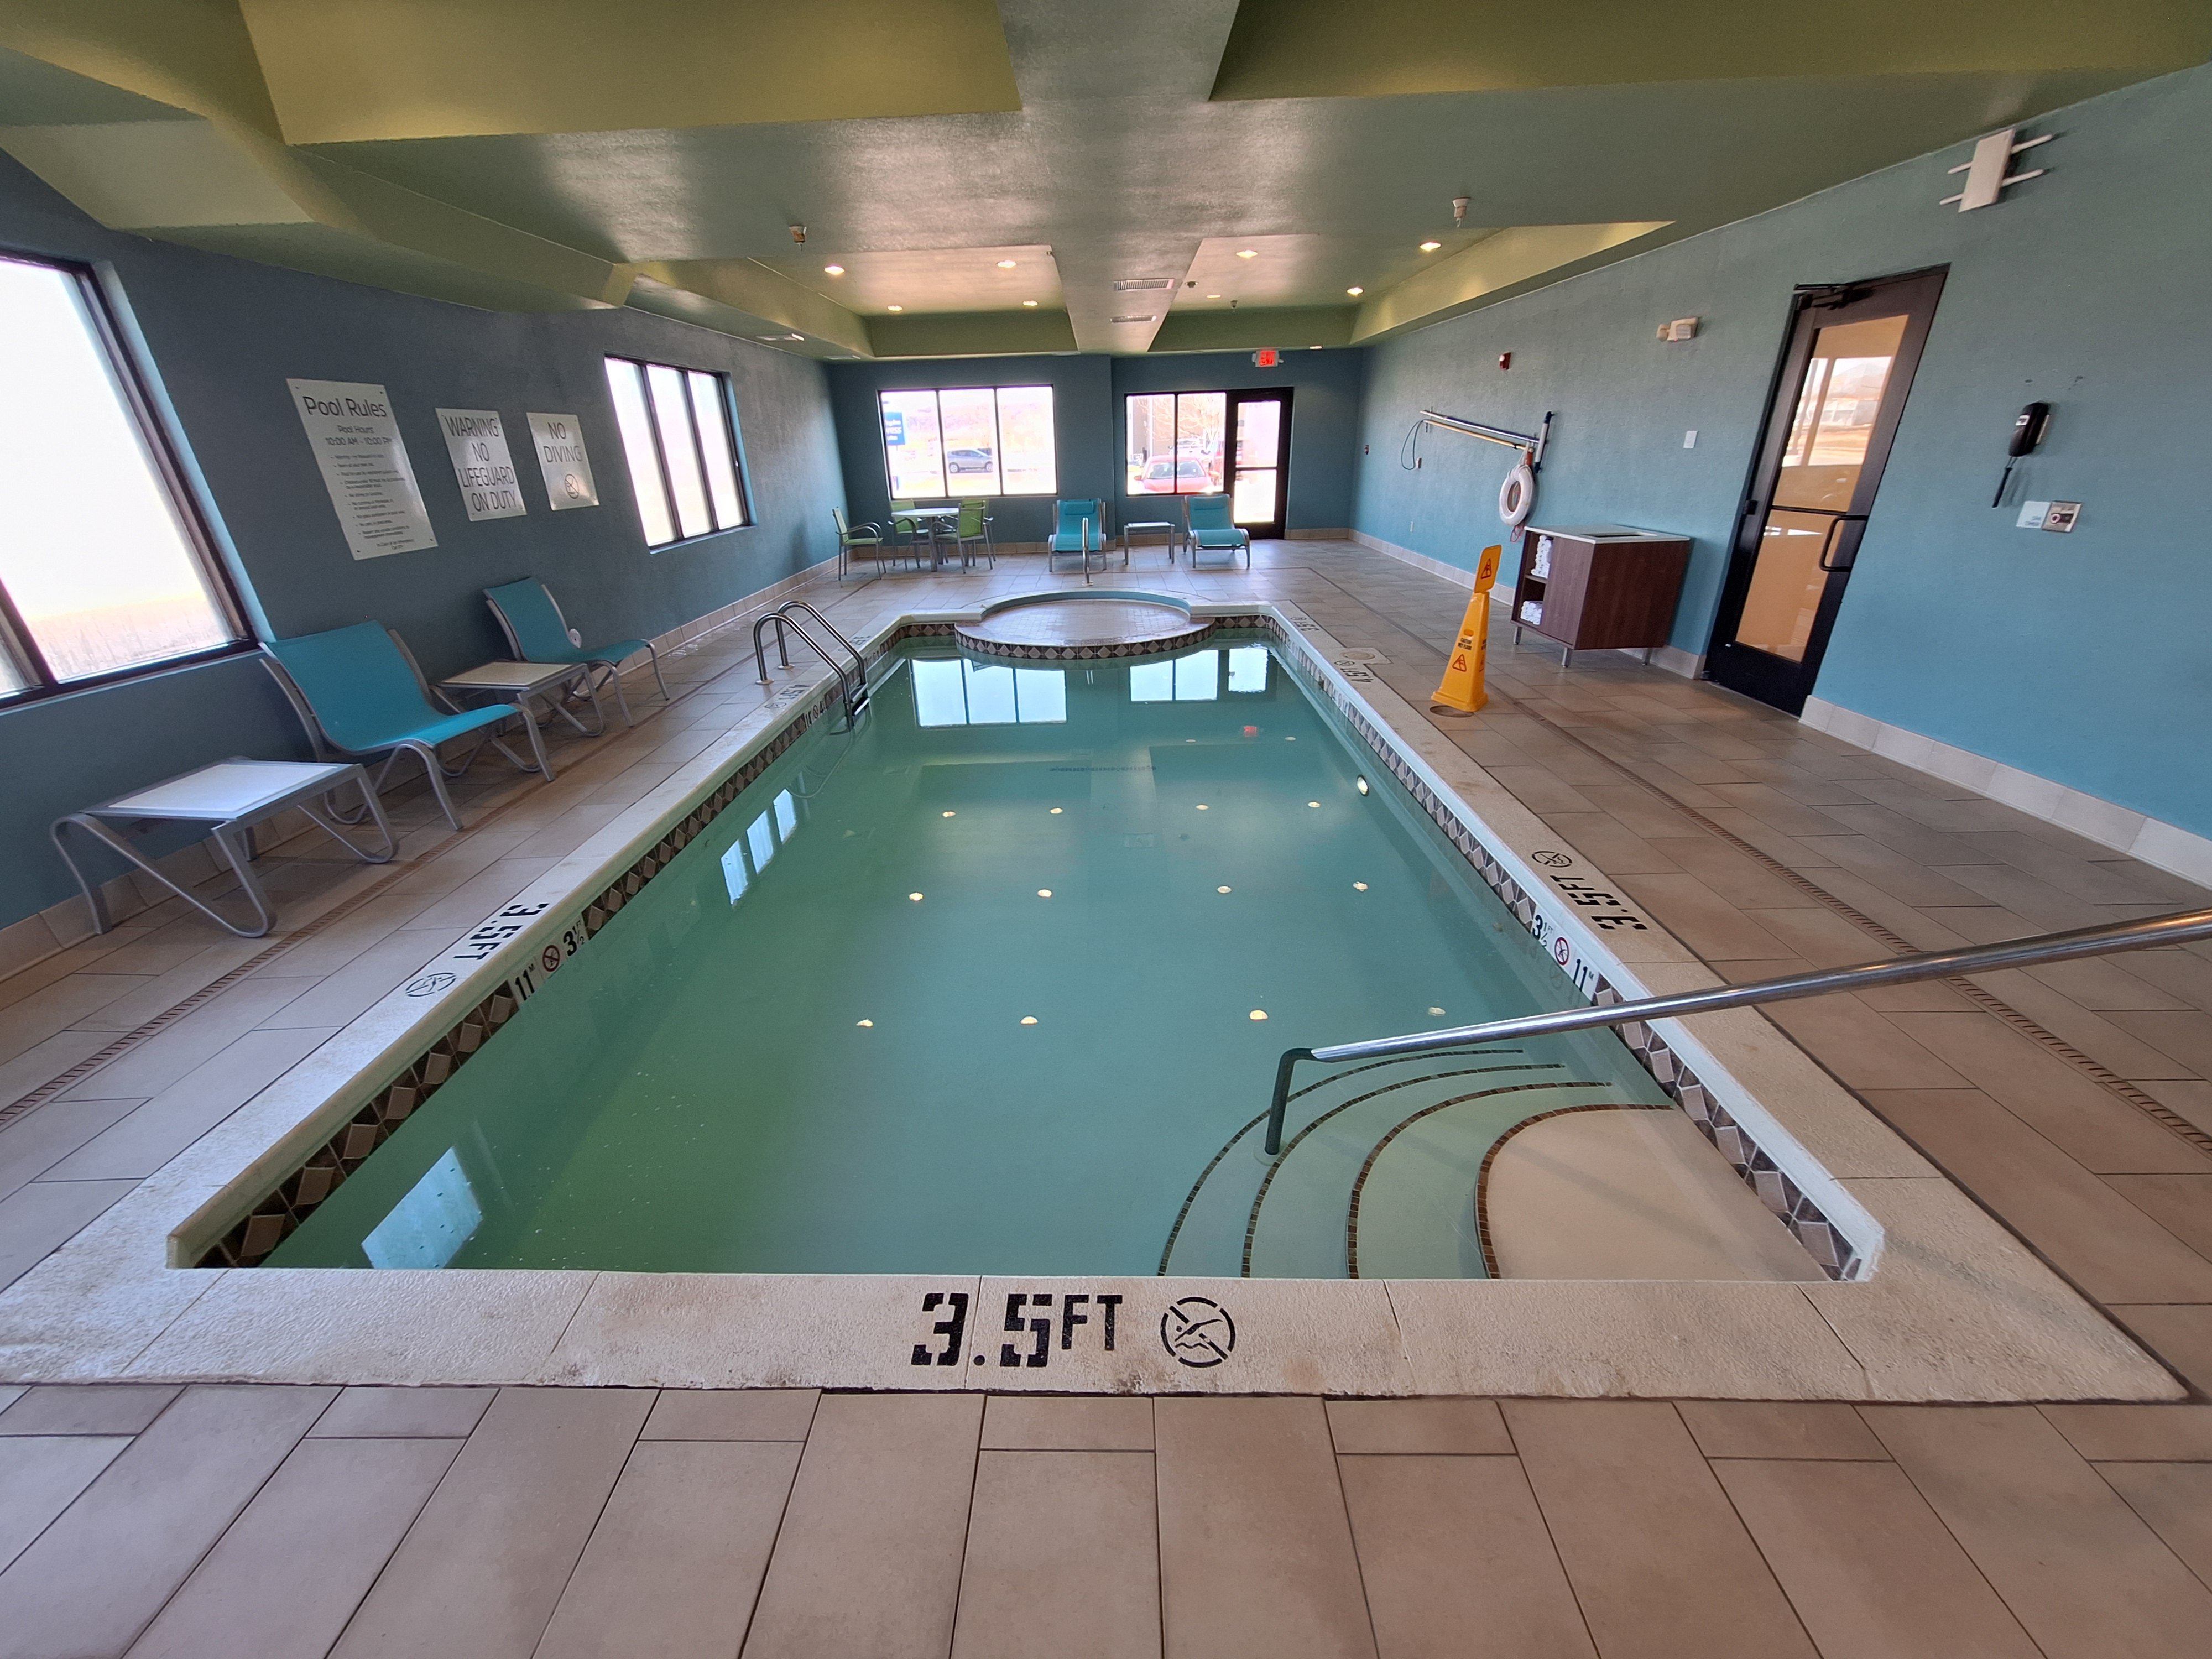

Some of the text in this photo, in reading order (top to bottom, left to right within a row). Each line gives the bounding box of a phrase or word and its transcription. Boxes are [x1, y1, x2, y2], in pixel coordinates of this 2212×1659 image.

[302, 396, 387, 417] Pool Rules
[337, 425, 353, 433] Pool
[445, 416, 499, 437] WARNING
[547, 422, 566, 440] NO
[471, 442, 489, 462] NO
[543, 446, 582, 463] DIVING
[458, 466, 515, 488] LIFEGUARD
[471, 490, 517, 512] ON DUTY
[1549, 875, 1648, 930] 3.5FT
[452, 902, 550, 960] 3.5FT
